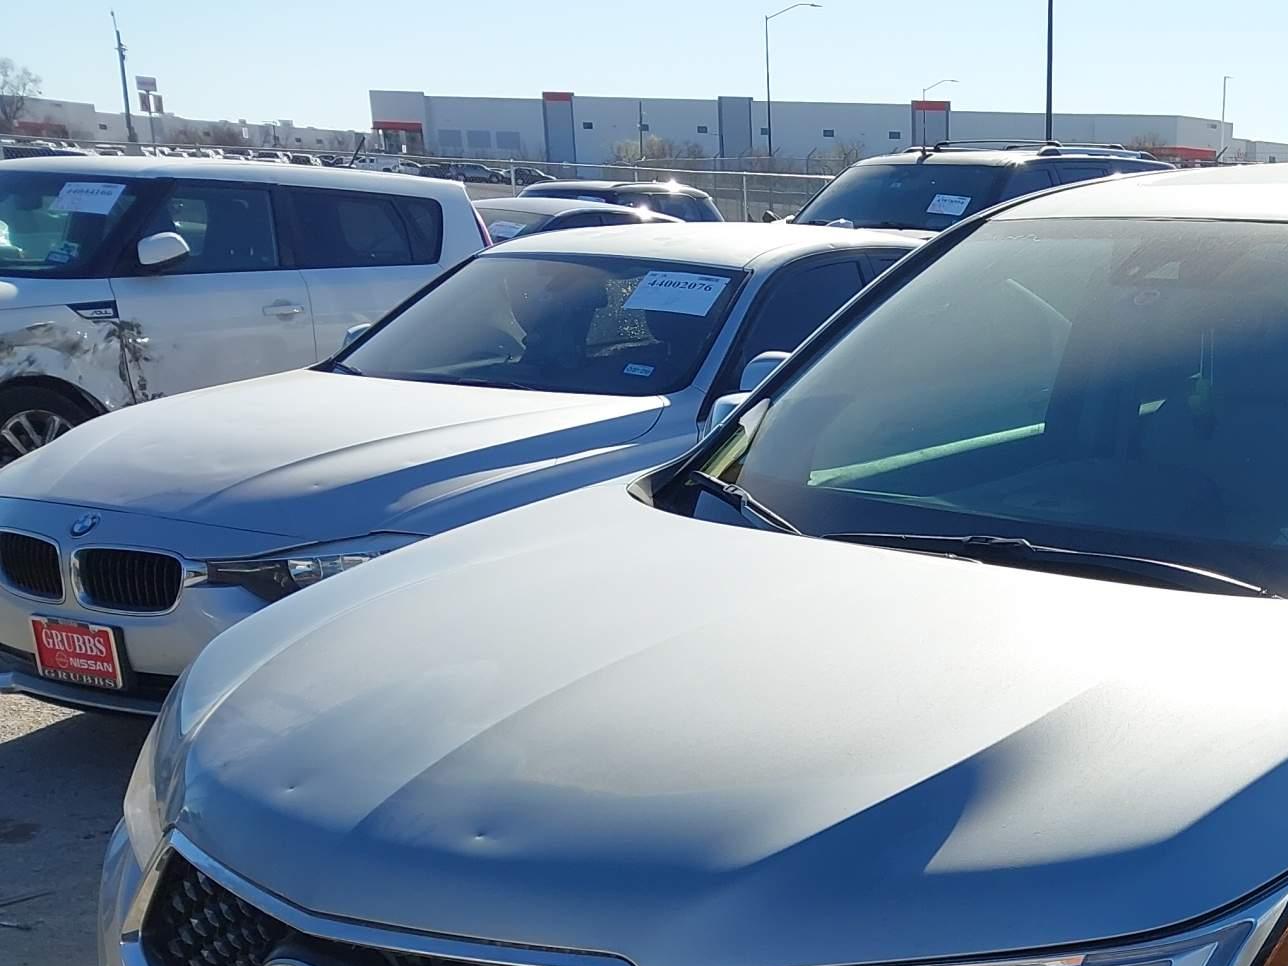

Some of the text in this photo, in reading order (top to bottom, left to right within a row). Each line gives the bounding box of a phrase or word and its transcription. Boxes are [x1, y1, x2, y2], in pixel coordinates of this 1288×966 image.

[647, 280, 712, 292] 44002076
[42, 628, 106, 657] GRUBBS
[69, 657, 113, 673] NISSAN
[45, 669, 115, 689] GRUBBS
